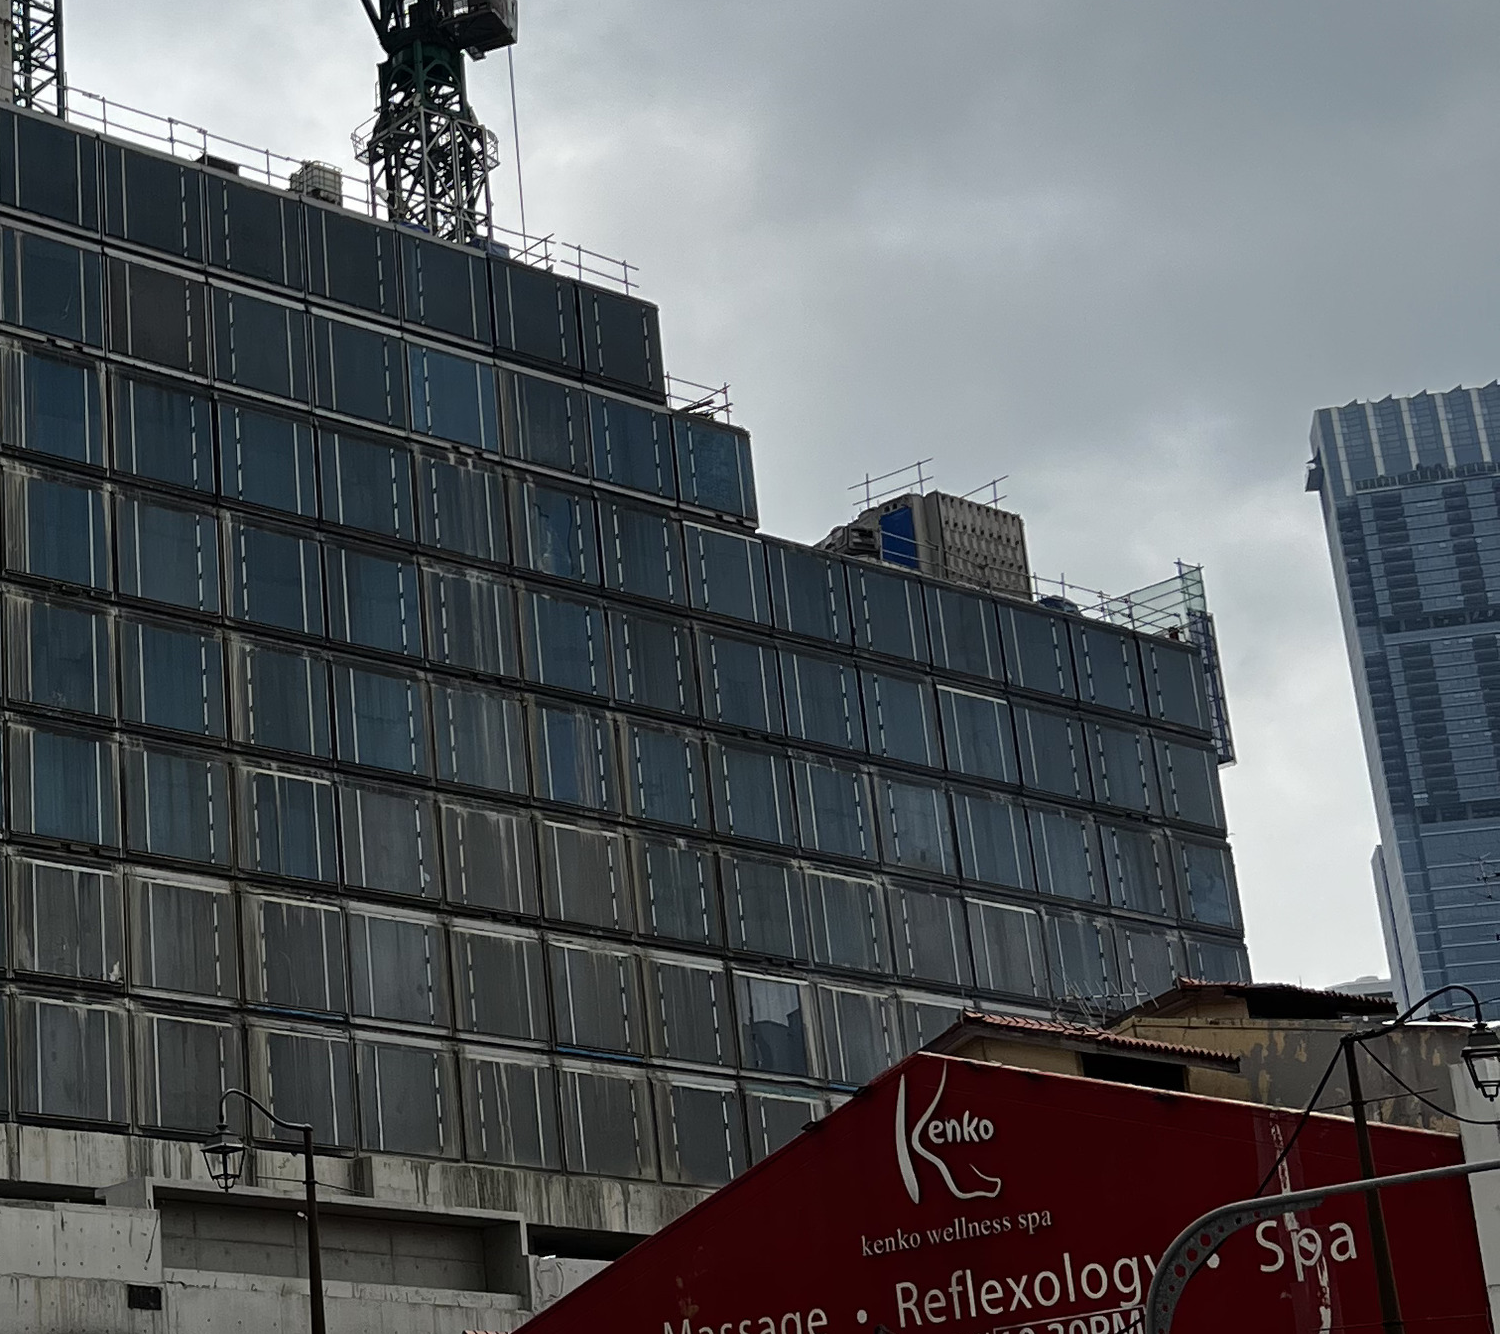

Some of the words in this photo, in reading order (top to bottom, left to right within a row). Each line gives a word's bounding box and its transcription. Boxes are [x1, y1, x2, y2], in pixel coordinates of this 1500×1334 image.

[896, 1060, 1001, 1204] Kenko
[862, 1228, 921, 1257] kenko
[927, 1217, 1012, 1245] wellness
[1018, 1210, 1052, 1235] spa
[1255, 1219, 1358, 1282] Spa
